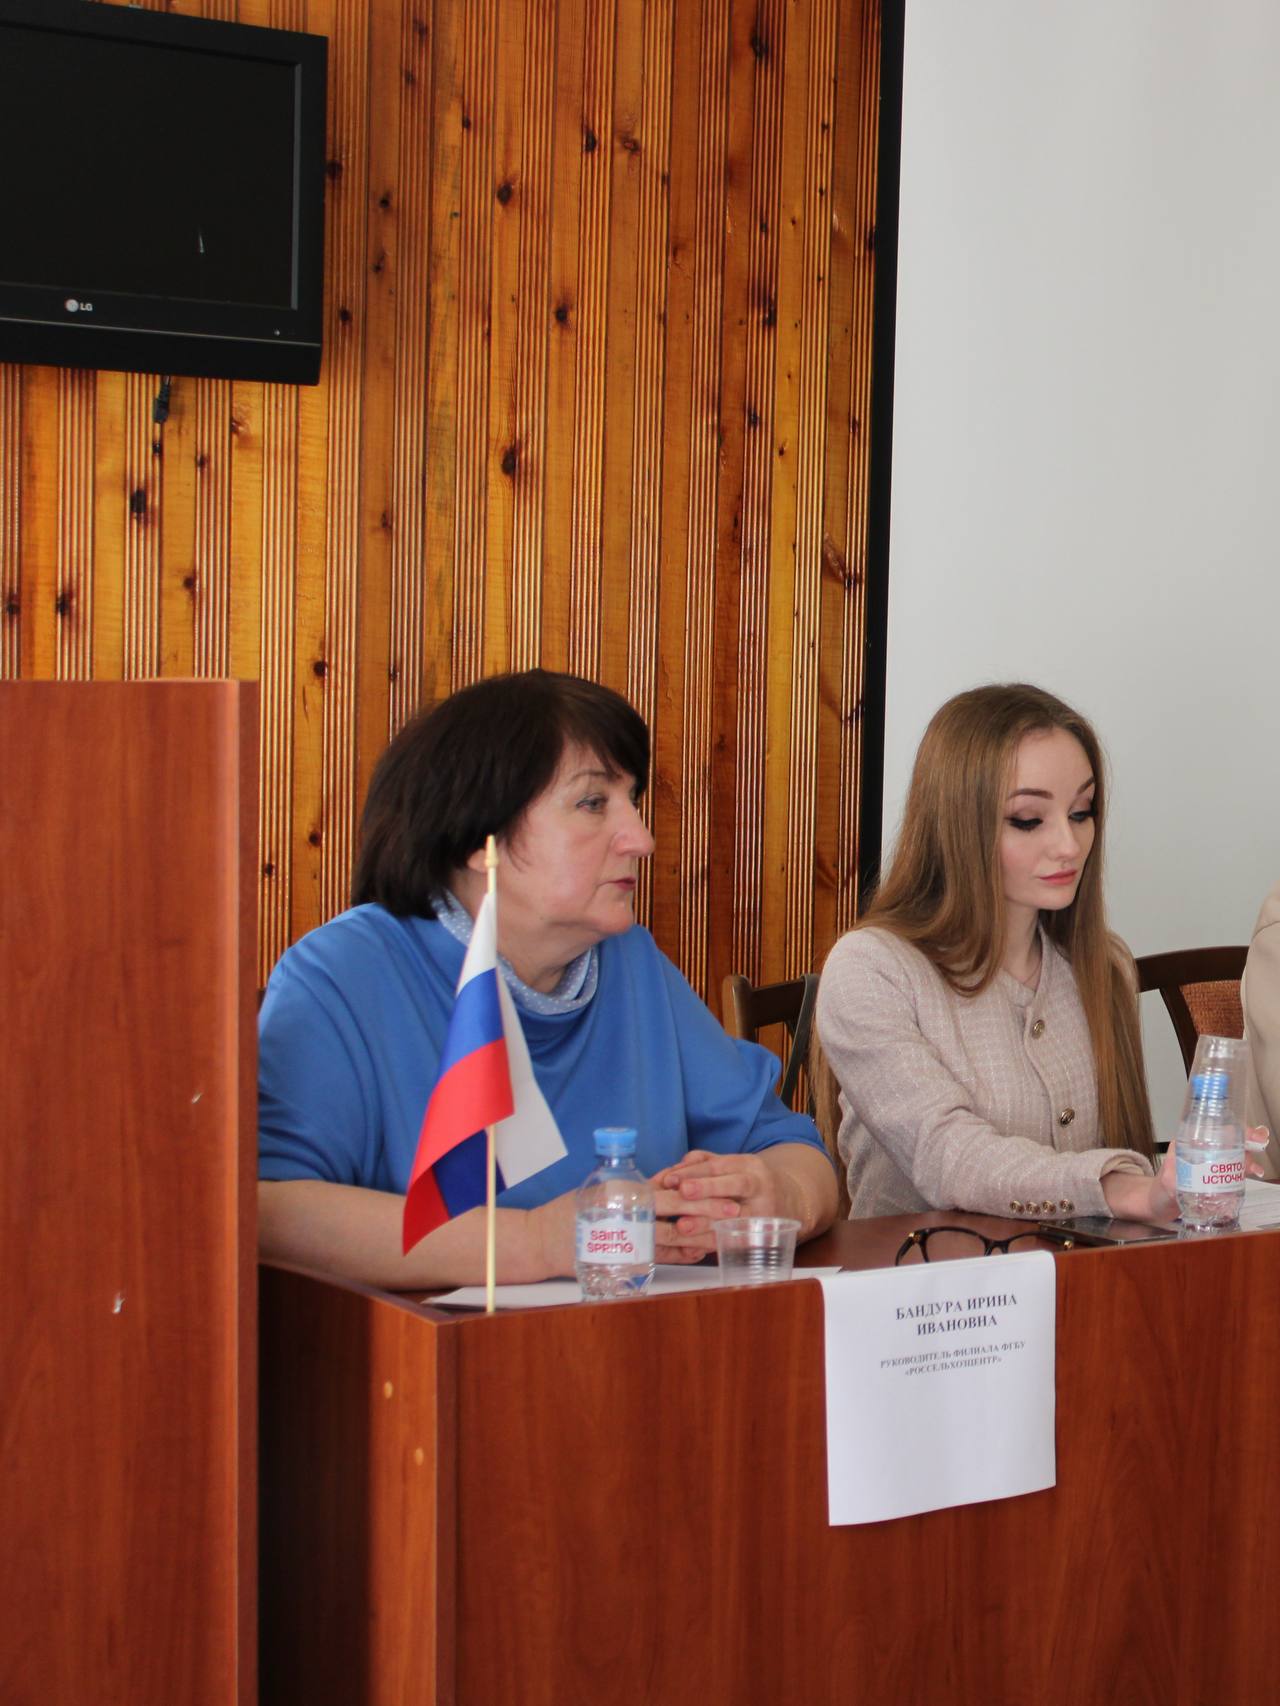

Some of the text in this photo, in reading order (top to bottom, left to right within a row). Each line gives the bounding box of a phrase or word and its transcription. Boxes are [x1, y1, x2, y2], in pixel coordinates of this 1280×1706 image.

[80, 302, 93, 311] LG
[895, 1293, 1018, 1321] БАНДУРА ИРИНА
[917, 1314, 998, 1336] ИВАНОВНА
[880, 1351, 952, 1369] РУКОВОДИТЕЛЬ
[953, 1344, 1000, 1358] ФИЛИАЛА
